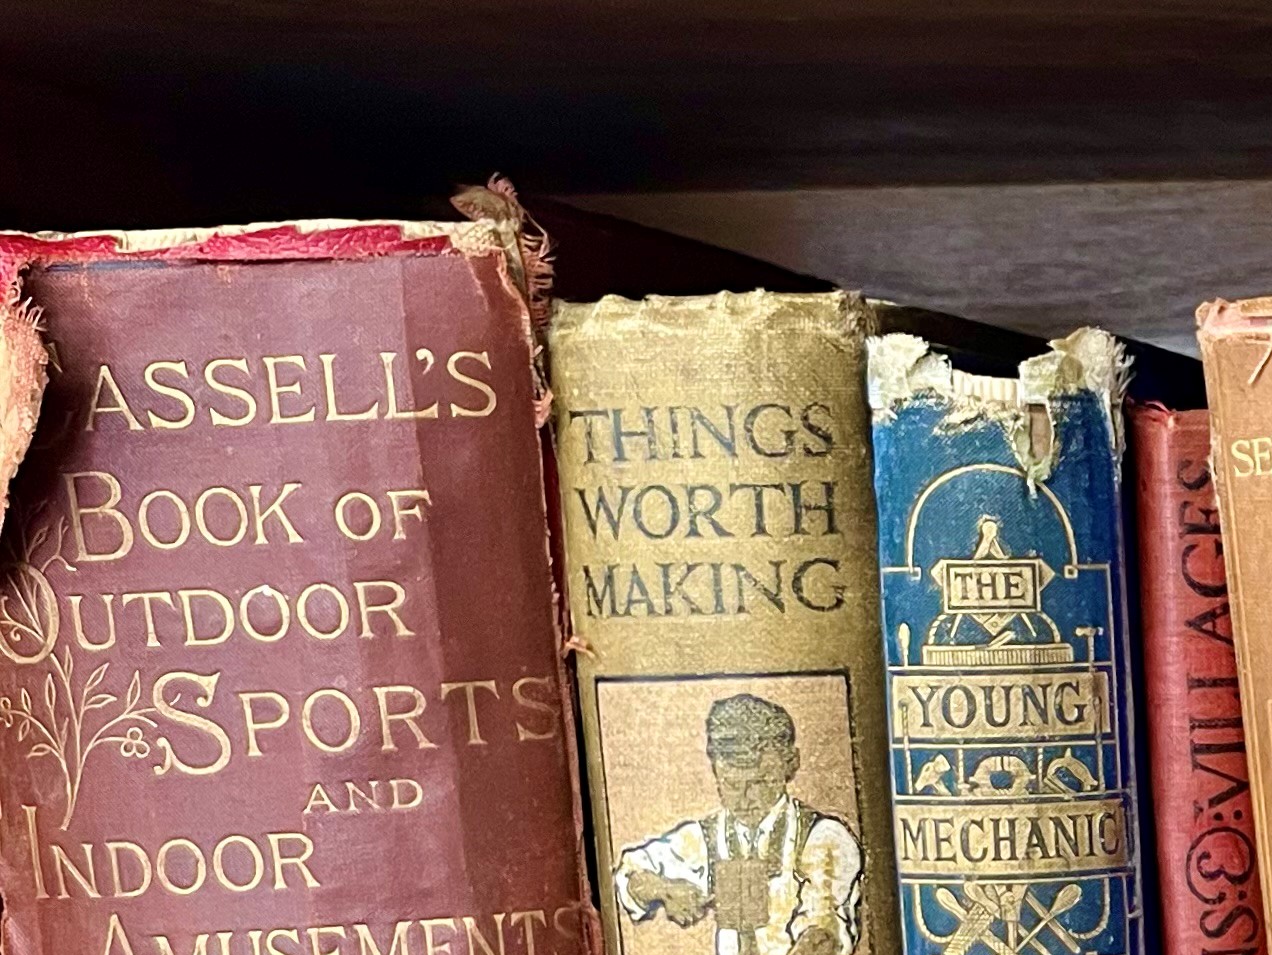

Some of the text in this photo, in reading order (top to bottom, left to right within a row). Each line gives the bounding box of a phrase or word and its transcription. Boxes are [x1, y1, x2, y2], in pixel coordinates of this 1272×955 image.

[85, 349, 498, 431] ASSELL'S
[569, 402, 835, 465] THINGS
[64, 471, 431, 562] BOOK OF
[574, 481, 840, 541] WORTH
[0, 563, 416, 663] OUTDOOR
[582, 557, 846, 618] MAKING
[953, 571, 1026, 601] THE
[152, 671, 559, 775] SPORTS
[908, 681, 1087, 729] YOUNG
[303, 779, 424, 814] AND
[20, 804, 321, 899] INDOOR
[900, 811, 1120, 864] MECHANIC
